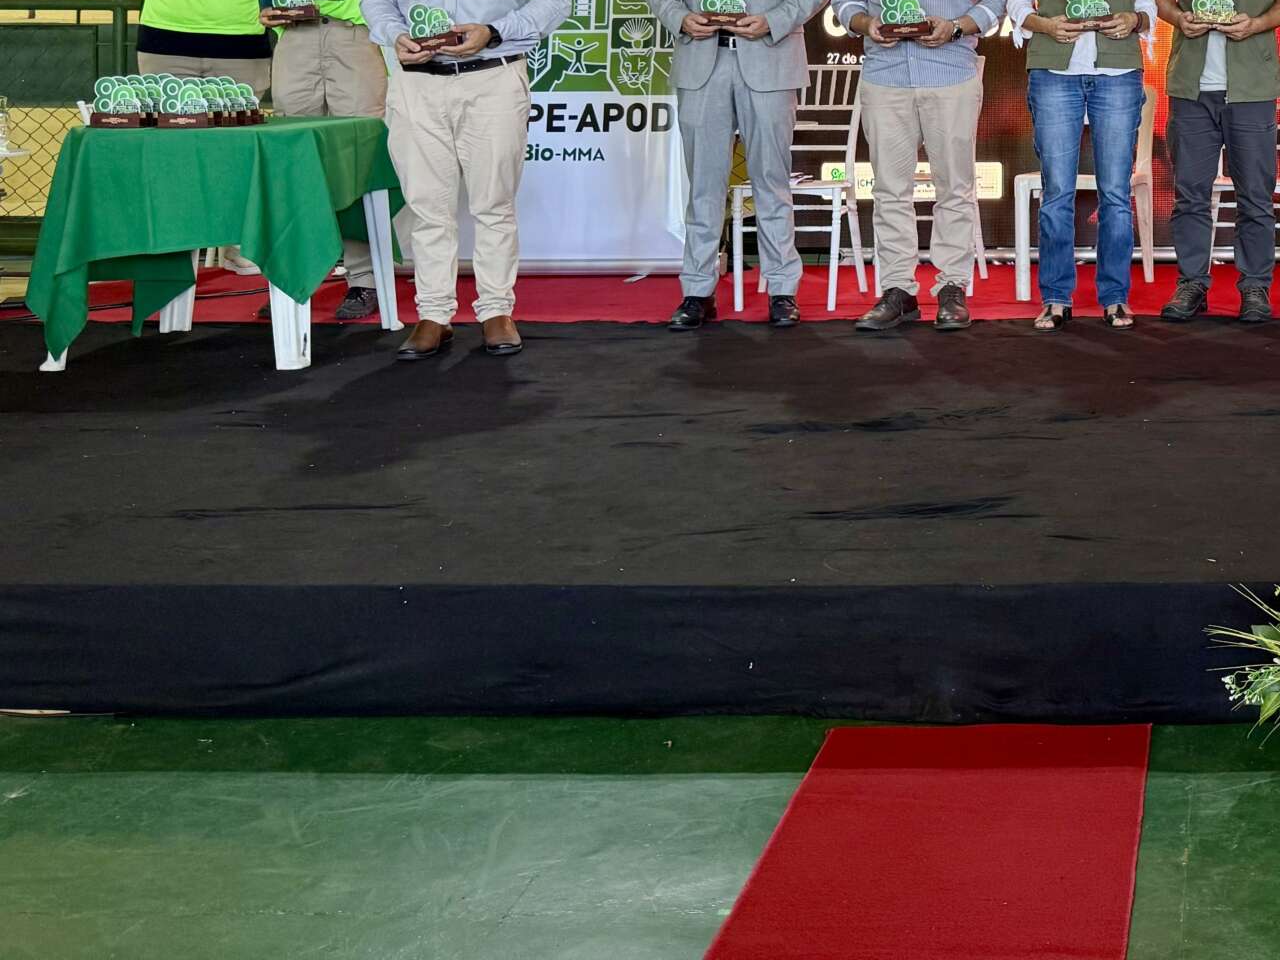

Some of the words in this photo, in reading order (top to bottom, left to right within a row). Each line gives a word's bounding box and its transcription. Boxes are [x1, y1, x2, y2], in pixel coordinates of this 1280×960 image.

[827, 52, 840, 64] 27
[527, 102, 675, 133] PE-APOD
[524, 144, 605, 162] Bio-MMA
